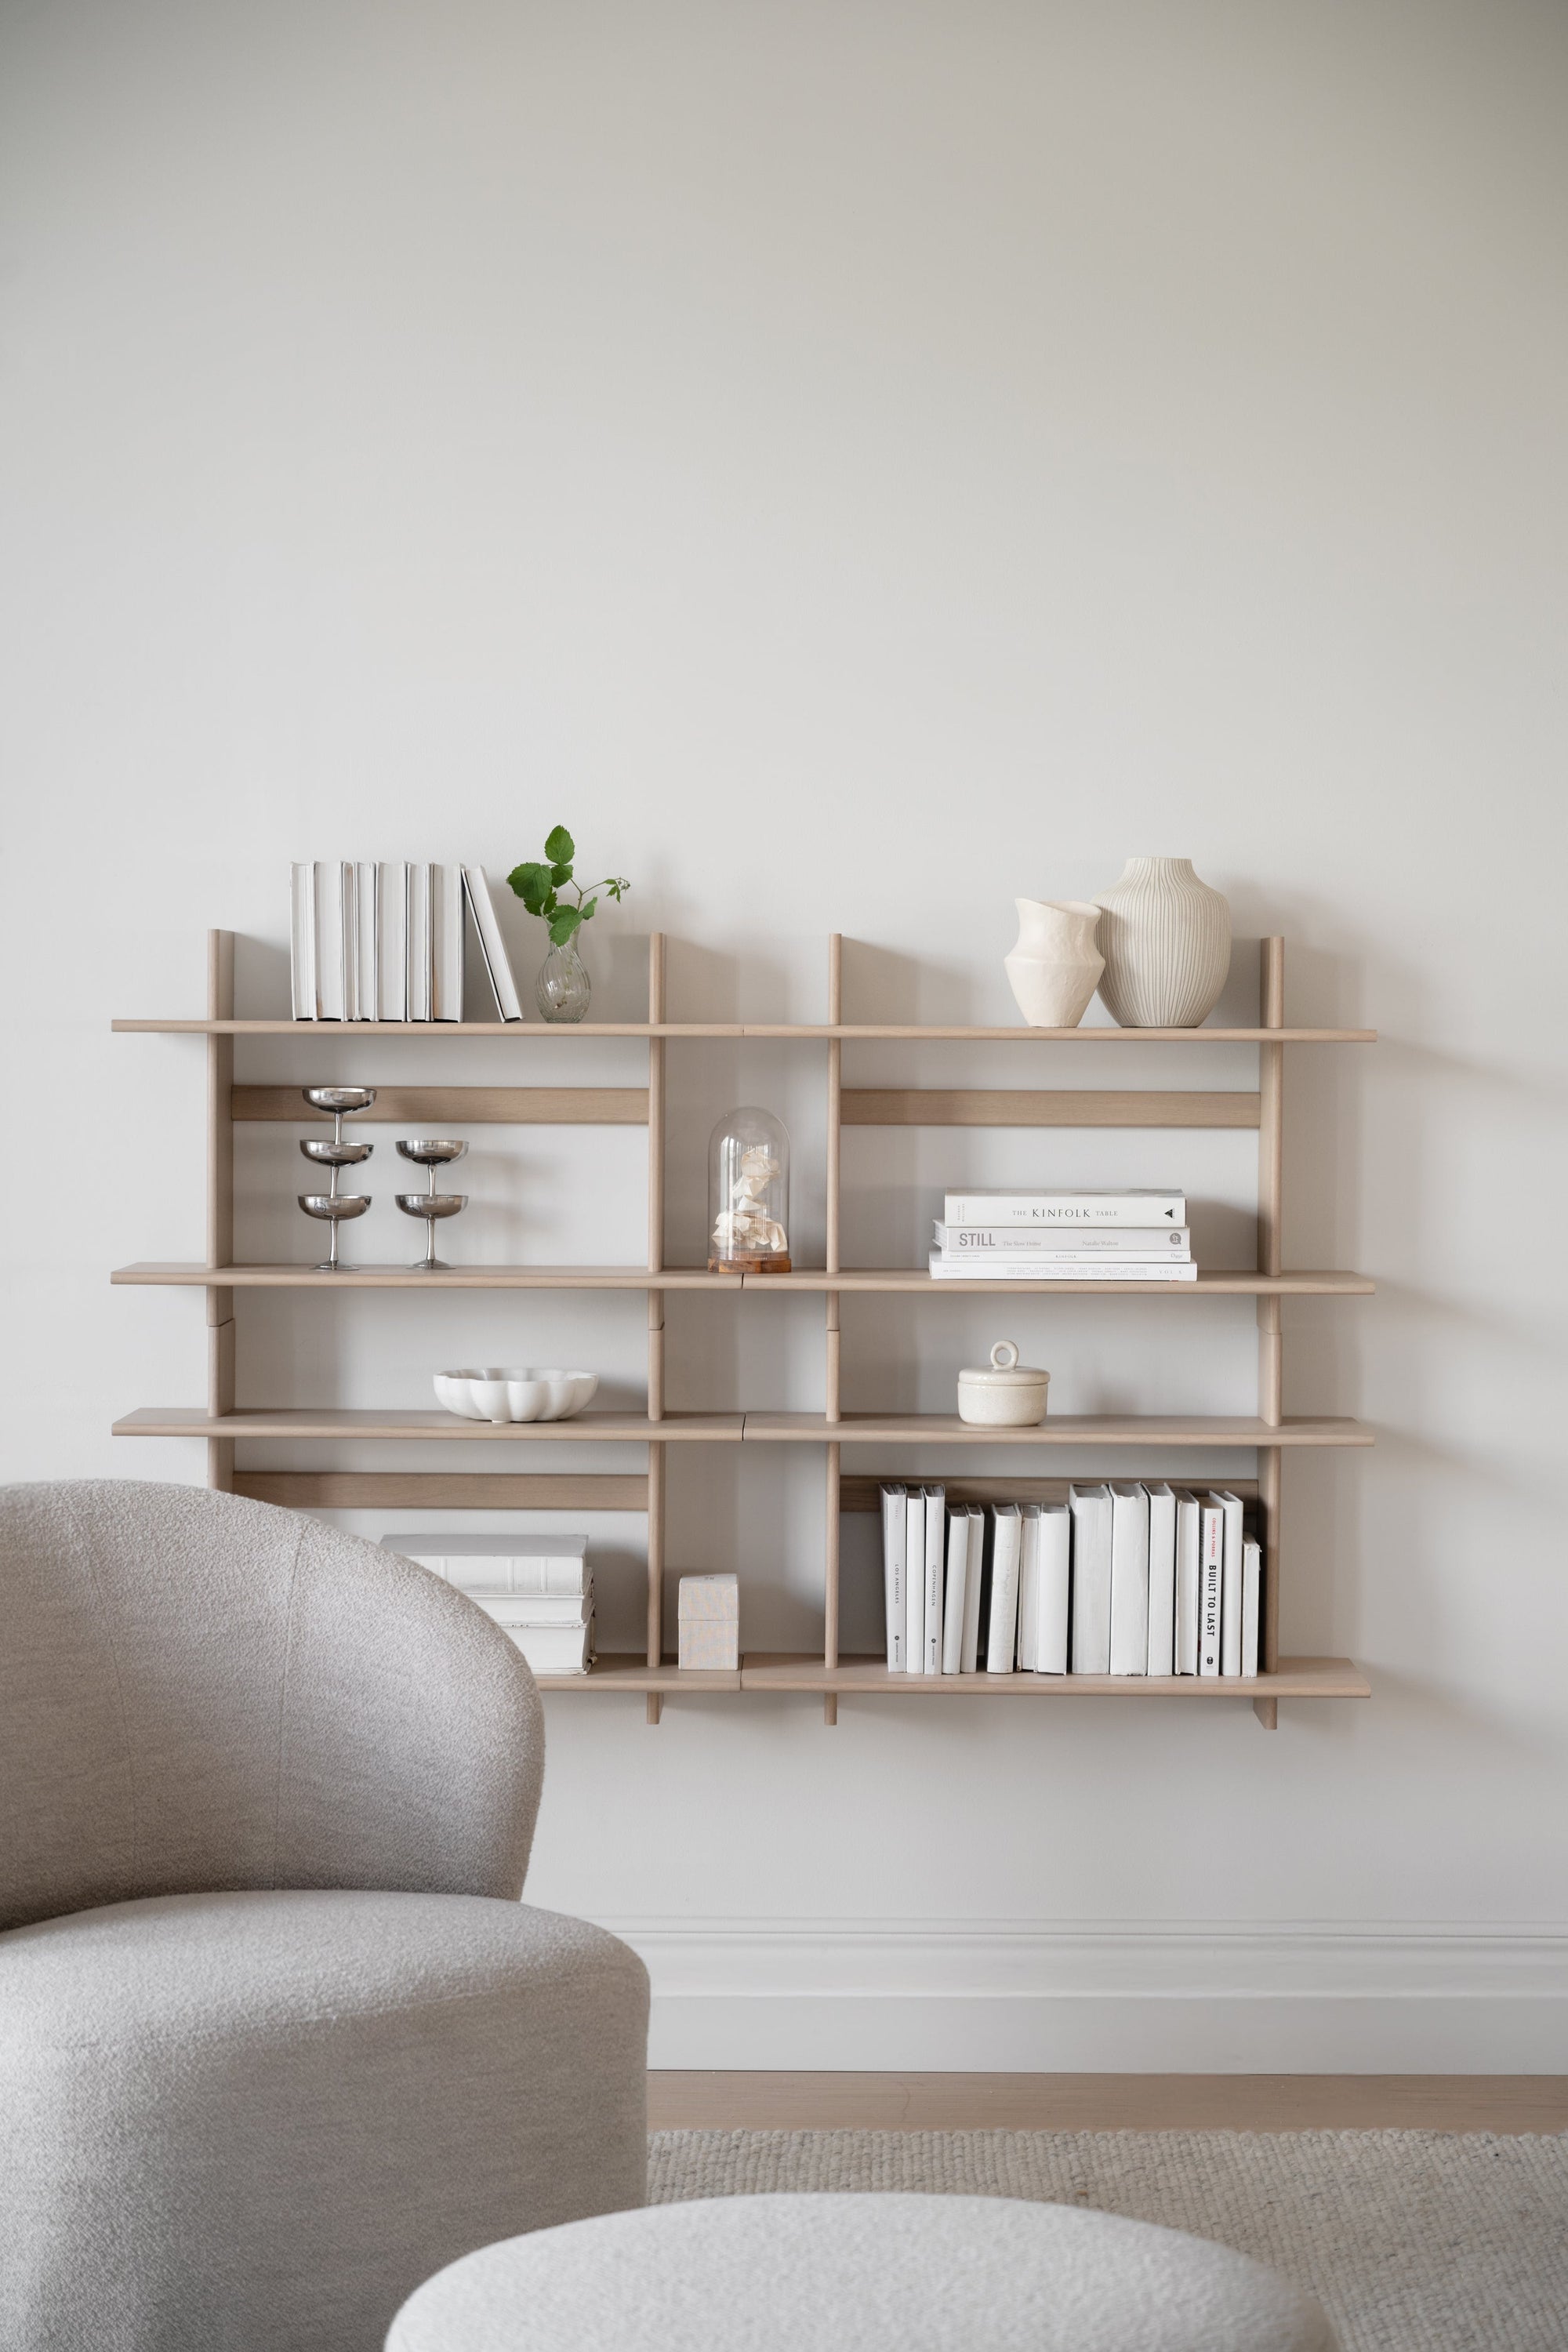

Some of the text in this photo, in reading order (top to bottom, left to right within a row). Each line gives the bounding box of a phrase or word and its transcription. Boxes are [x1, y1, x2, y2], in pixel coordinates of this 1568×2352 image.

[1032, 1209, 1091, 1218] KINFOLK
[959, 1232, 996, 1247] STILL
[1207, 1565, 1217, 1637] BUILT TO LAST
